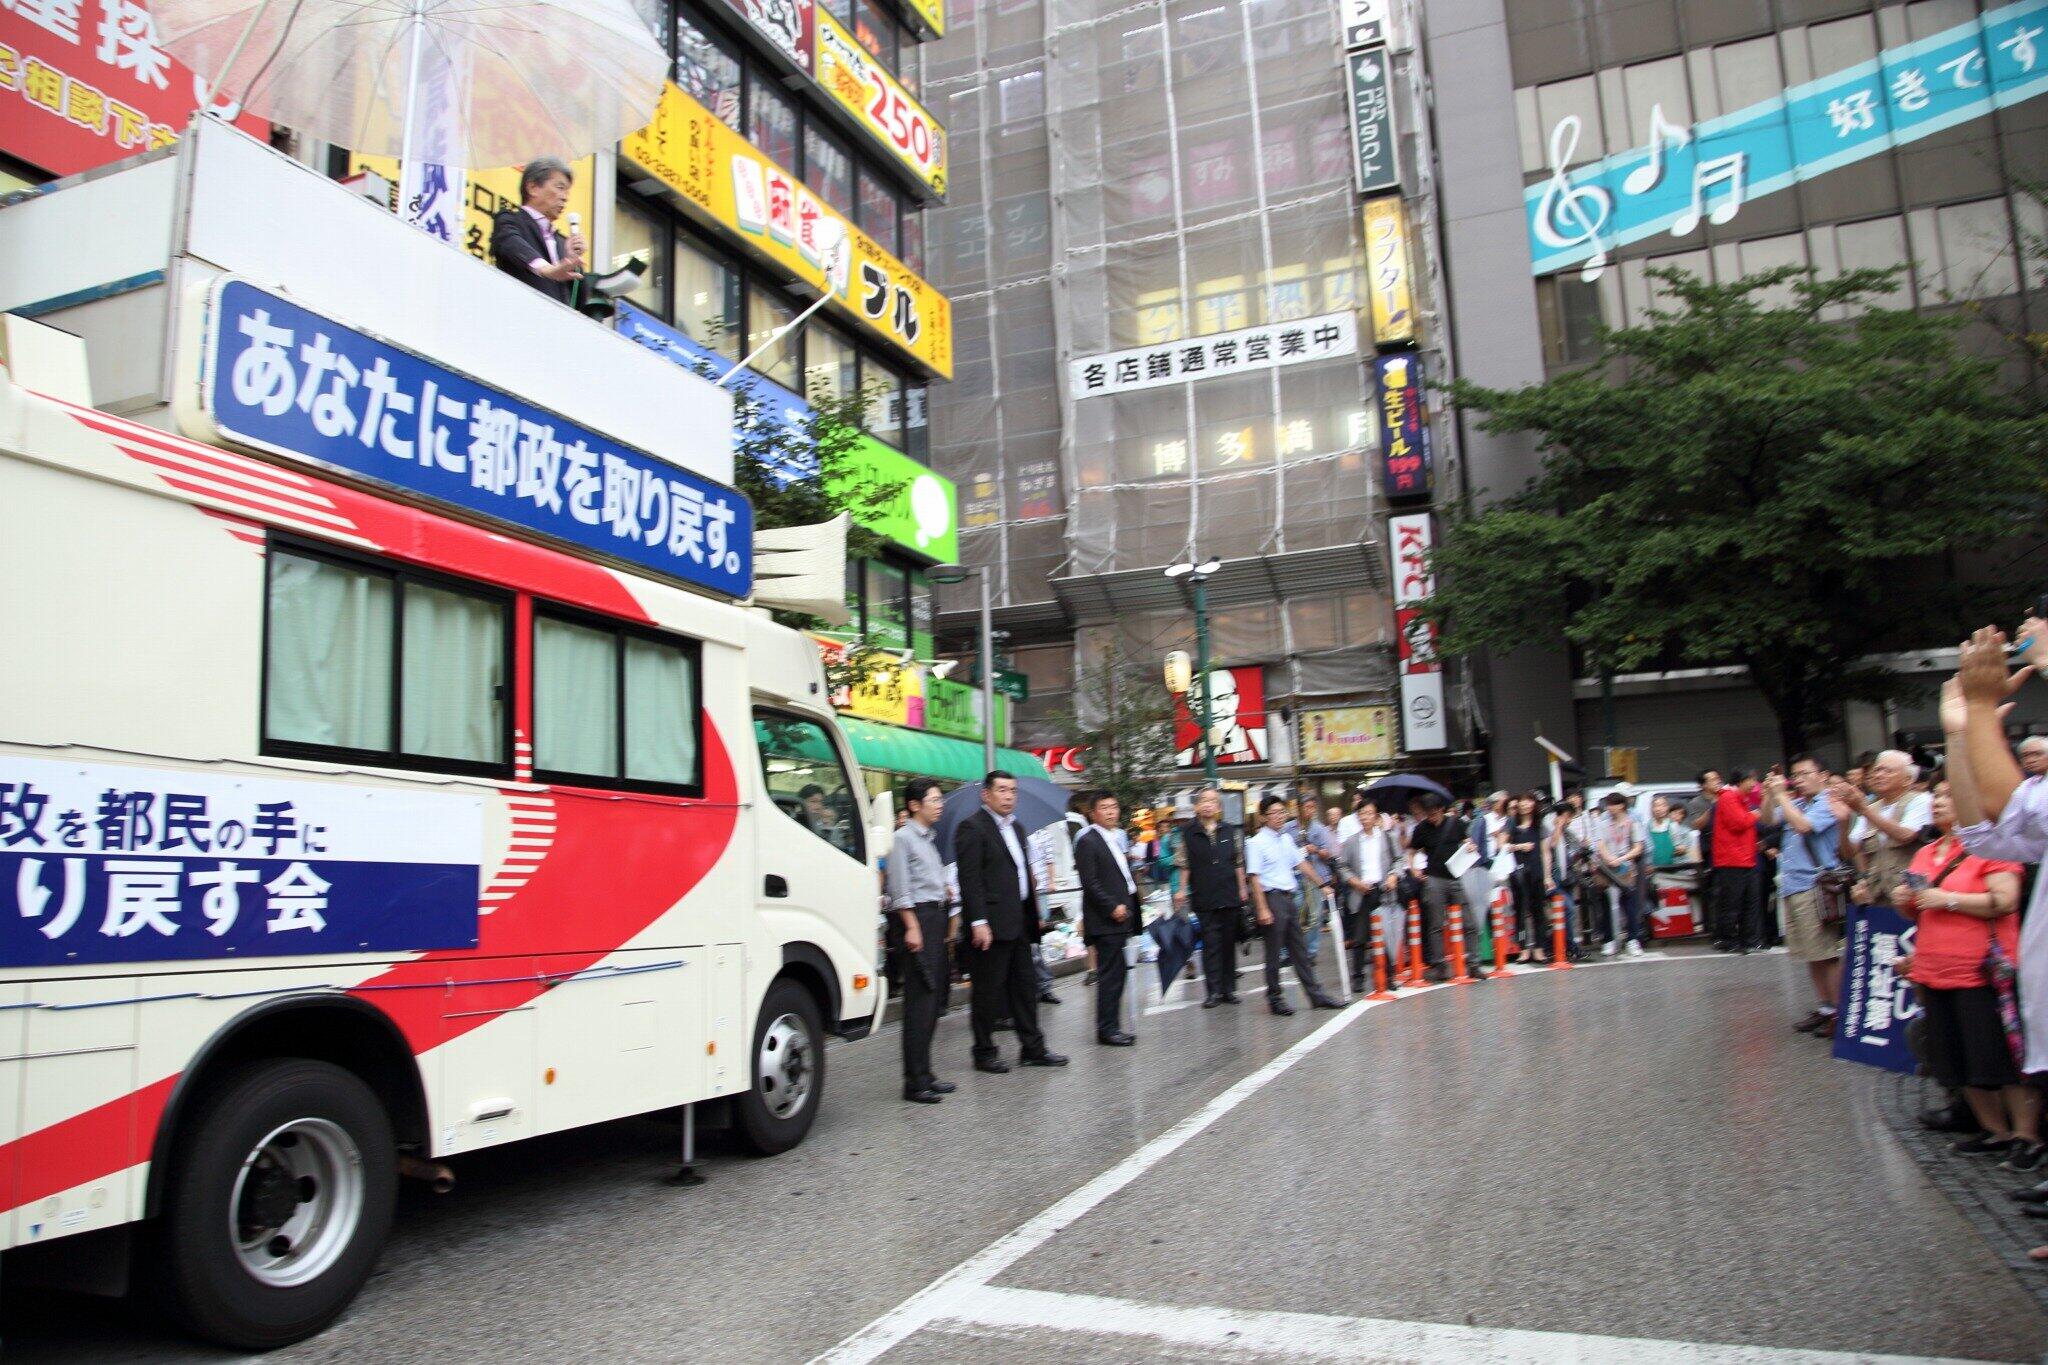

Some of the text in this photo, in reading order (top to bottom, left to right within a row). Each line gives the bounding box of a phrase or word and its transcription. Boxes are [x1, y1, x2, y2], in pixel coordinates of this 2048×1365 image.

[870, 71, 928, 164] 250
[1825, 26, 2045, 138] 好きです
[1356, 88, 1382, 179] コンタクト
[1373, 217, 1400, 313] ラフター
[1083, 323, 1341, 389] 各店舗通常営業中
[232, 308, 739, 575] あなたに都政を取り戻す。
[1398, 523, 1428, 597] KFC
[1030, 746, 1090, 773] FC
[17, 857, 332, 939] り戻す会
